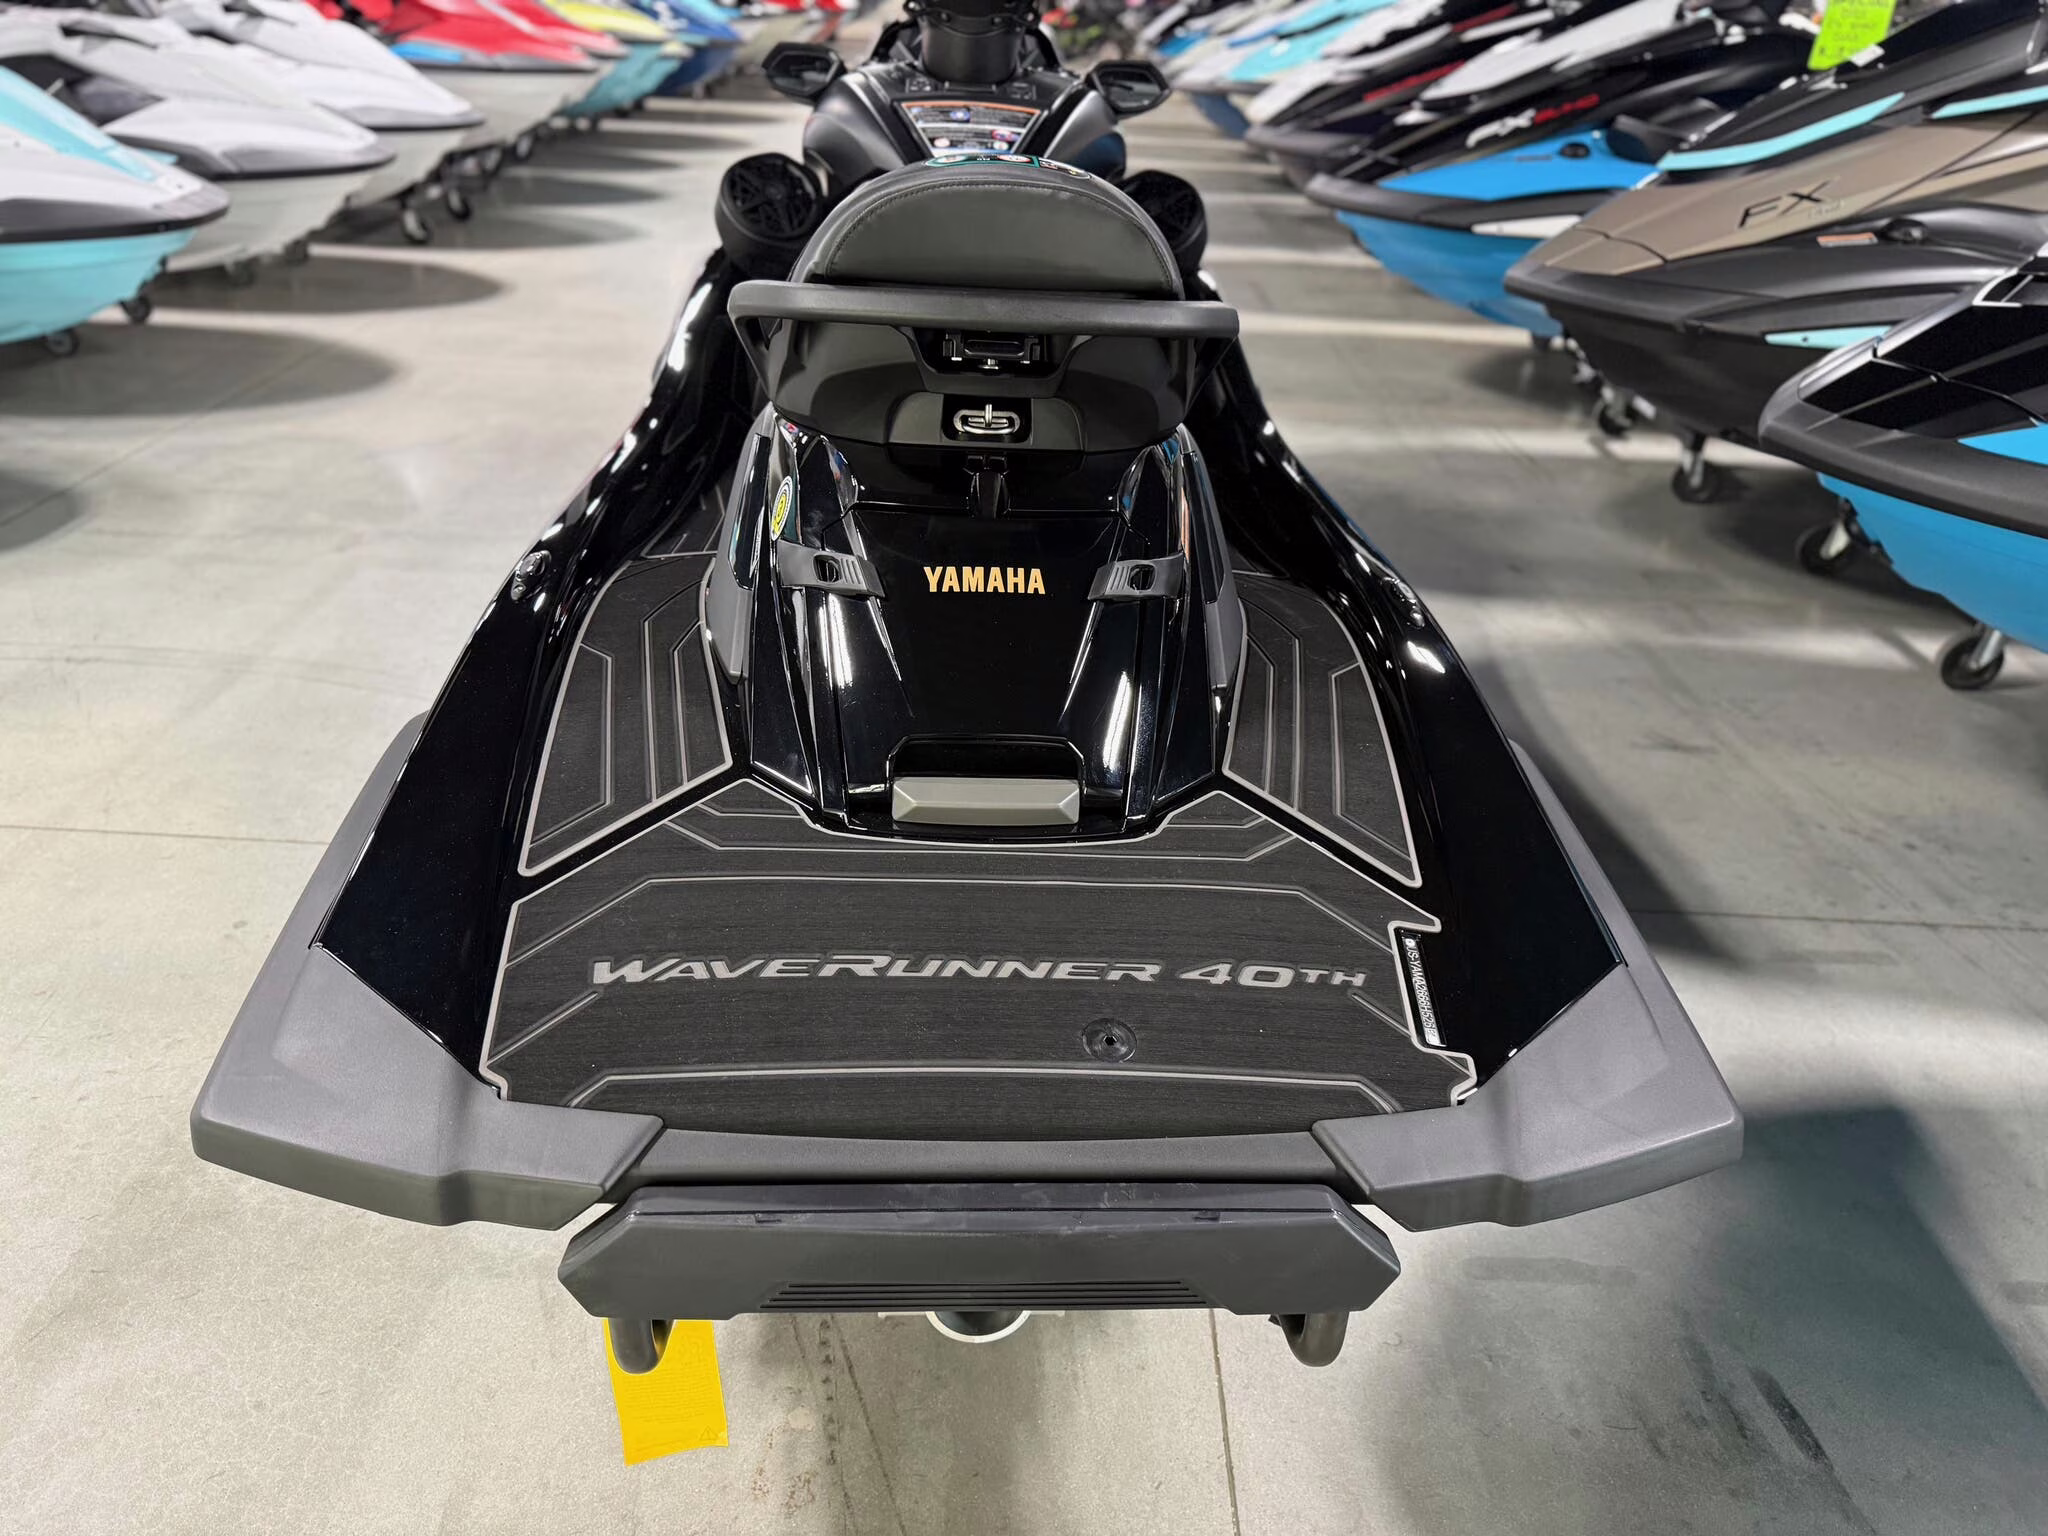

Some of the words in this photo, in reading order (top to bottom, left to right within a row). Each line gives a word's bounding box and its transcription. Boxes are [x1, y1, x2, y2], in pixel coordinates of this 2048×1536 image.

[1738, 179, 1831, 229] FX
[923, 566, 1046, 595] YAMAHA
[1179, 962, 1367, 988] 40TH
